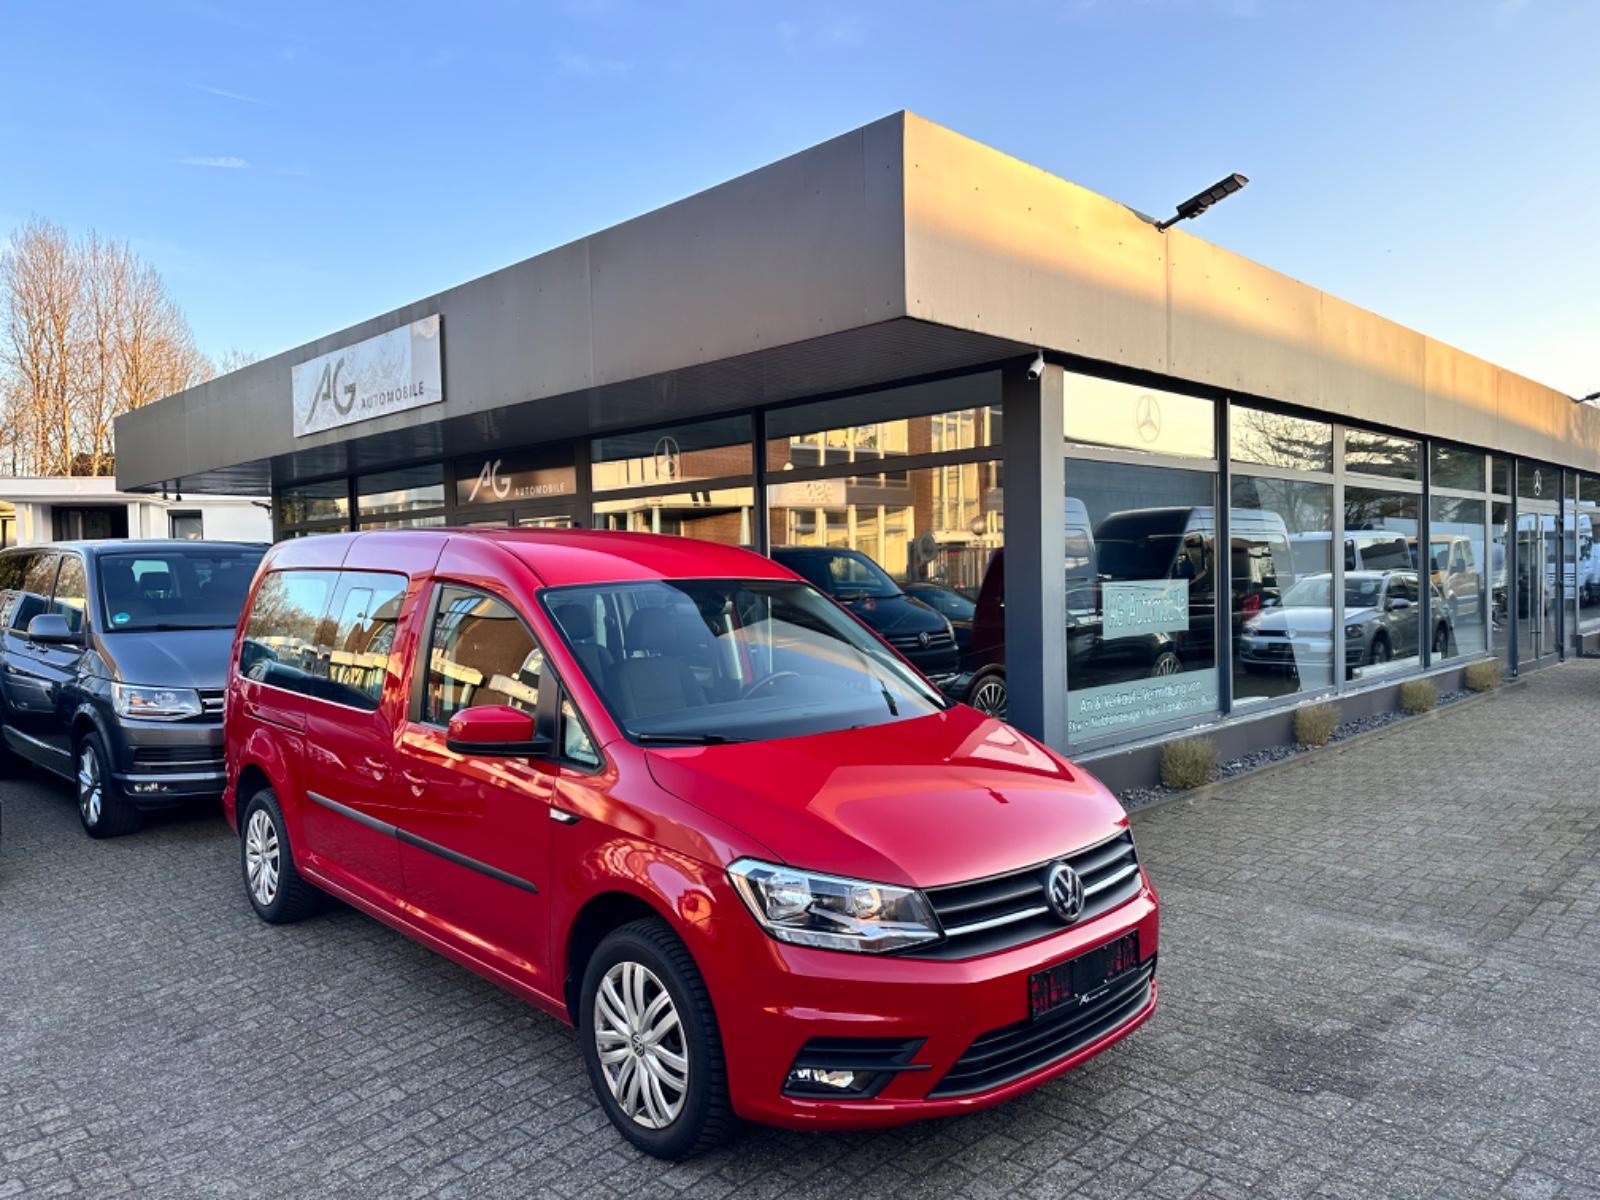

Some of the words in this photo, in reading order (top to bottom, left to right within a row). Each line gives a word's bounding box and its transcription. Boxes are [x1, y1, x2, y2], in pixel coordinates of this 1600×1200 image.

[306, 357, 356, 425] AG
[361, 381, 424, 409] AUTOMOBILE
[468, 459, 512, 502] AG
[513, 482, 565, 497] AUTOMOBILE
